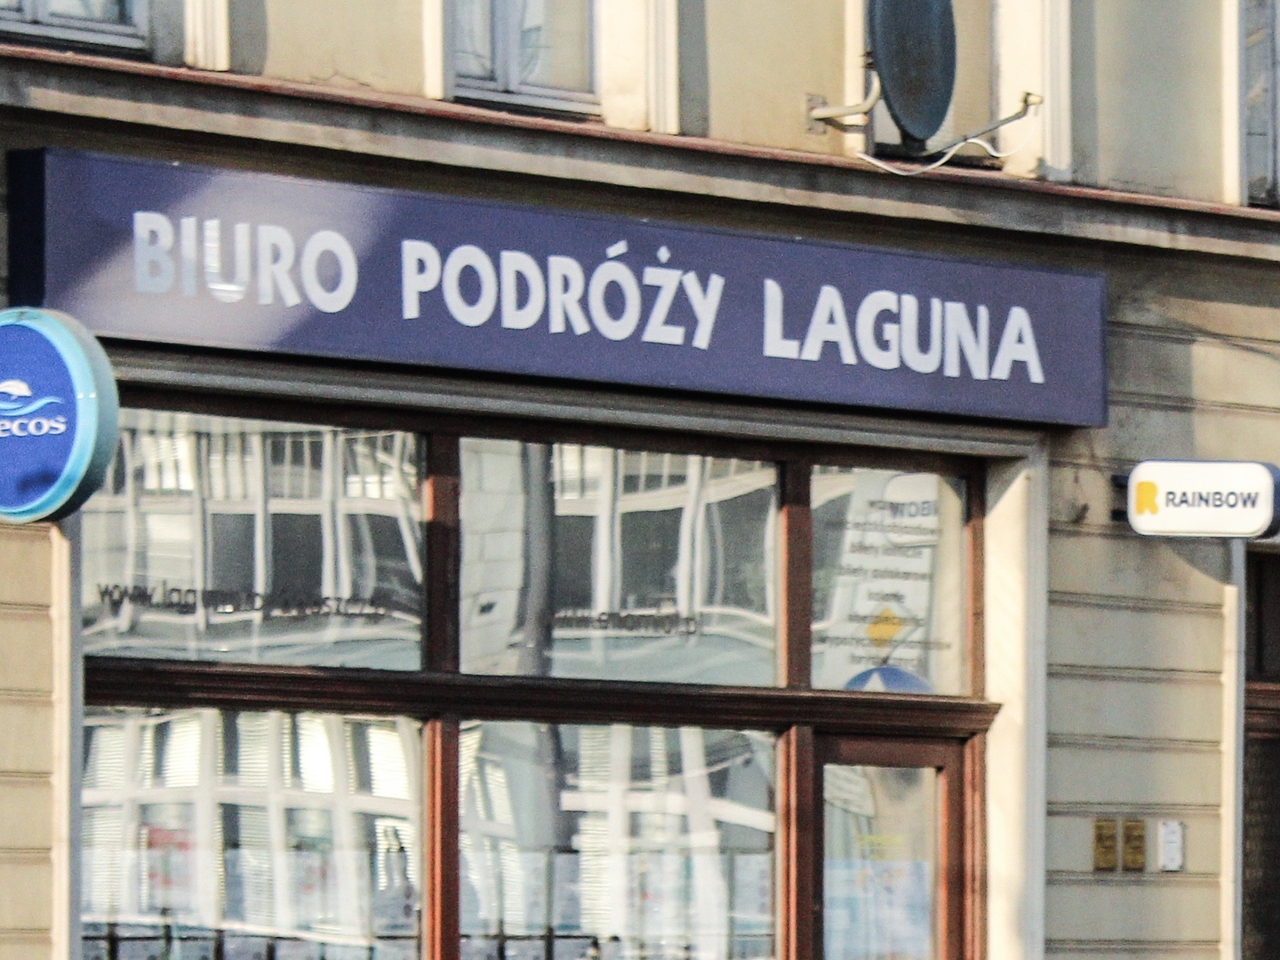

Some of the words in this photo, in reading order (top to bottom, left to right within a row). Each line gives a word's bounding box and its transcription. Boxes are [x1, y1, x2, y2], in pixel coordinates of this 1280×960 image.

[133, 211, 358, 313] BIURO
[402, 239, 725, 350] PODRÓŻY
[763, 278, 1045, 384] LAGUNA
[1166, 491, 1259, 508] RAINBOW
